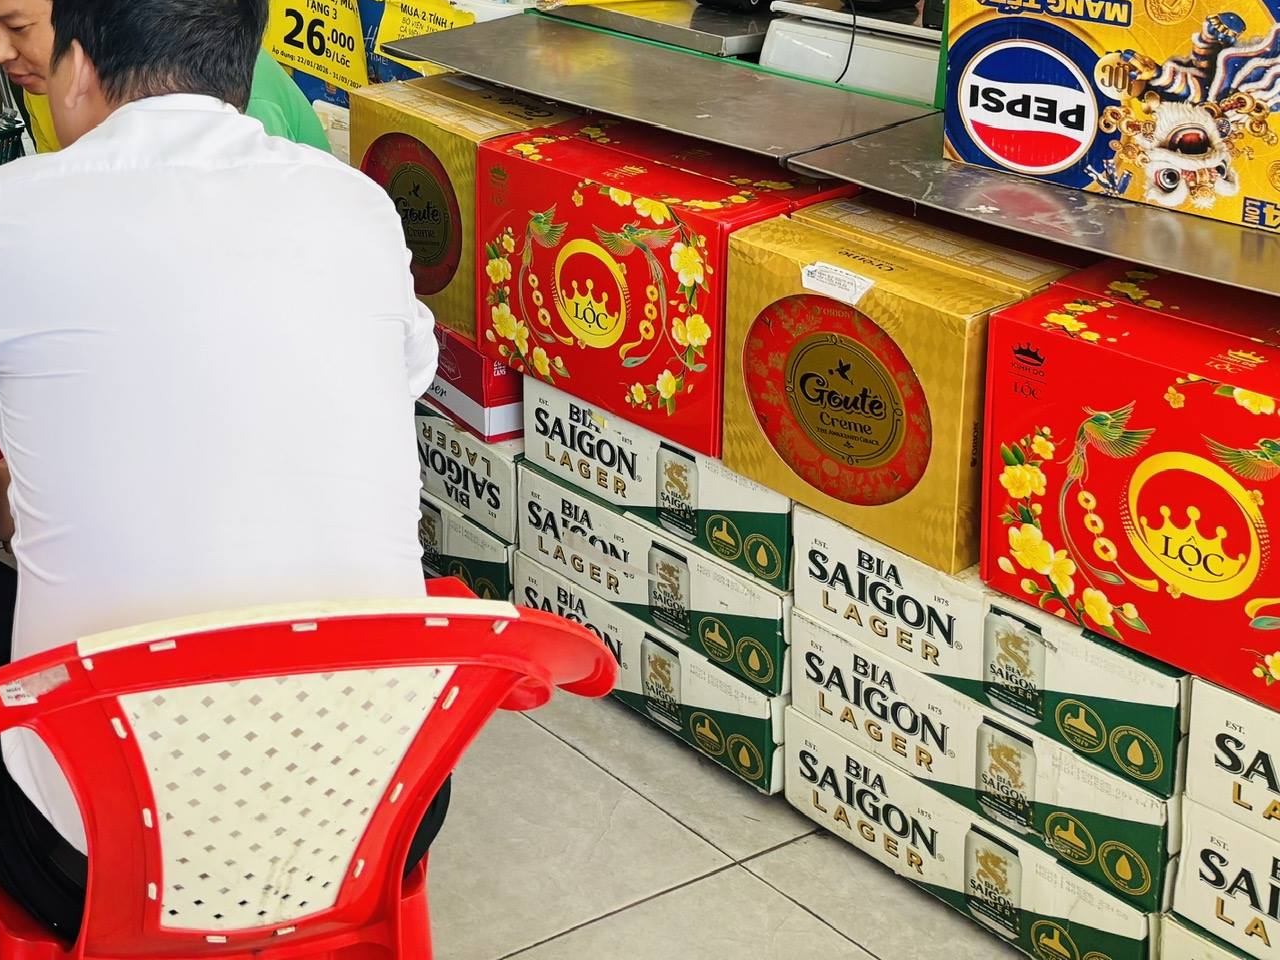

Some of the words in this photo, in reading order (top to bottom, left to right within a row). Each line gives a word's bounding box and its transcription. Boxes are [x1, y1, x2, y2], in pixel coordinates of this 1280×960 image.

[284, 8, 326, 56] 26
[333, 7, 337, 19] 3
[401, 3, 419, 18] MUA
[422, 12, 426, 20] 2
[429, 13, 447, 28] TÍNH
[969, 84, 1086, 131] PEPSI
[574, 301, 608, 331] LỘC
[799, 371, 887, 419] Gouté
[535, 407, 638, 481] SAIGON
[820, 412, 872, 435] Creme
[545, 441, 626, 498] LAGER
[858, 549, 903, 589] BIA
[1160, 534, 1225, 577] LỘC
[808, 549, 956, 649] SAIGON
[822, 590, 940, 666] LAGER
[853, 653, 897, 695] BIA
[805, 651, 950, 755] SAIGON
[819, 691, 933, 773] LAGER
[846, 755, 888, 798] BIA
[799, 750, 938, 860] SAIGON
[812, 790, 924, 875] LAGER
